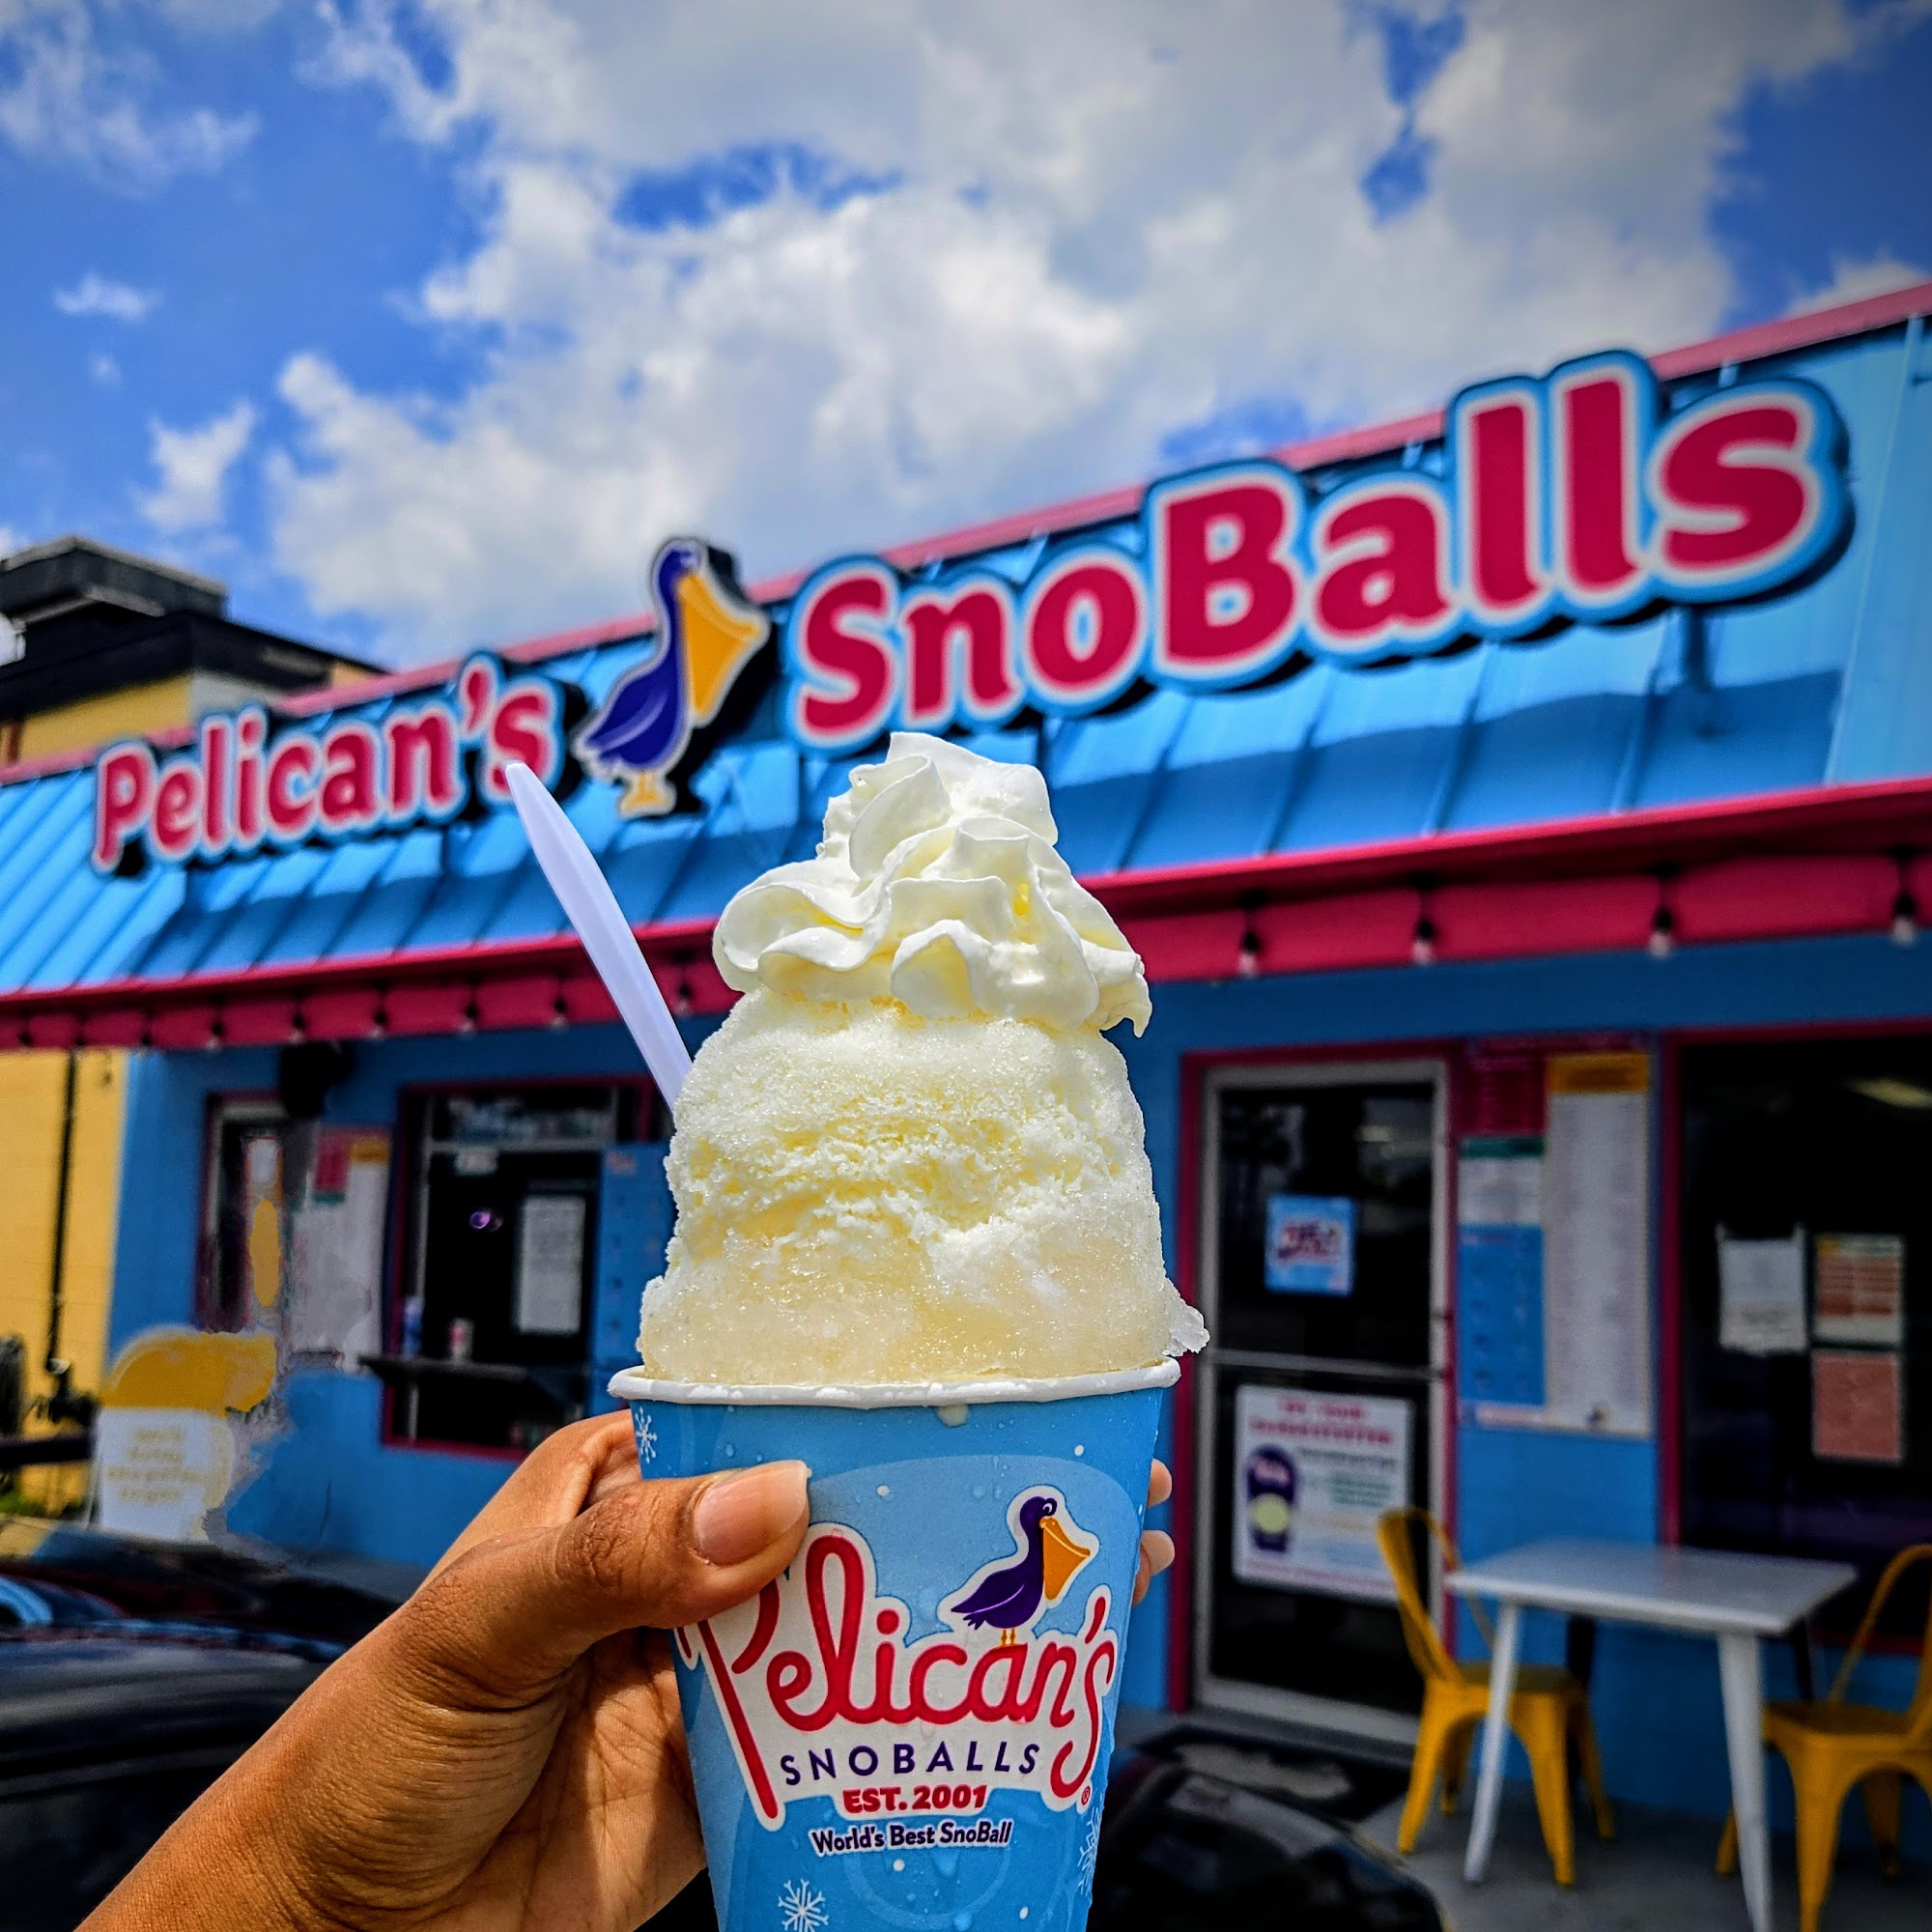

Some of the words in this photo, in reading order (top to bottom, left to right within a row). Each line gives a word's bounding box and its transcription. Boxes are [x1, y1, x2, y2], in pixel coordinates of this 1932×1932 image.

[796, 375, 1812, 744] SnoBalls
[97, 663, 554, 867] Pelican's
[780, 1740, 1039, 1786] SNOBALLS
[842, 1787, 908, 1814] EST.
[912, 1784, 988, 1810] 2001
[811, 1826, 885, 1853] World's
[889, 1824, 936, 1847] Best
[940, 1821, 1012, 1846] SnoBall
